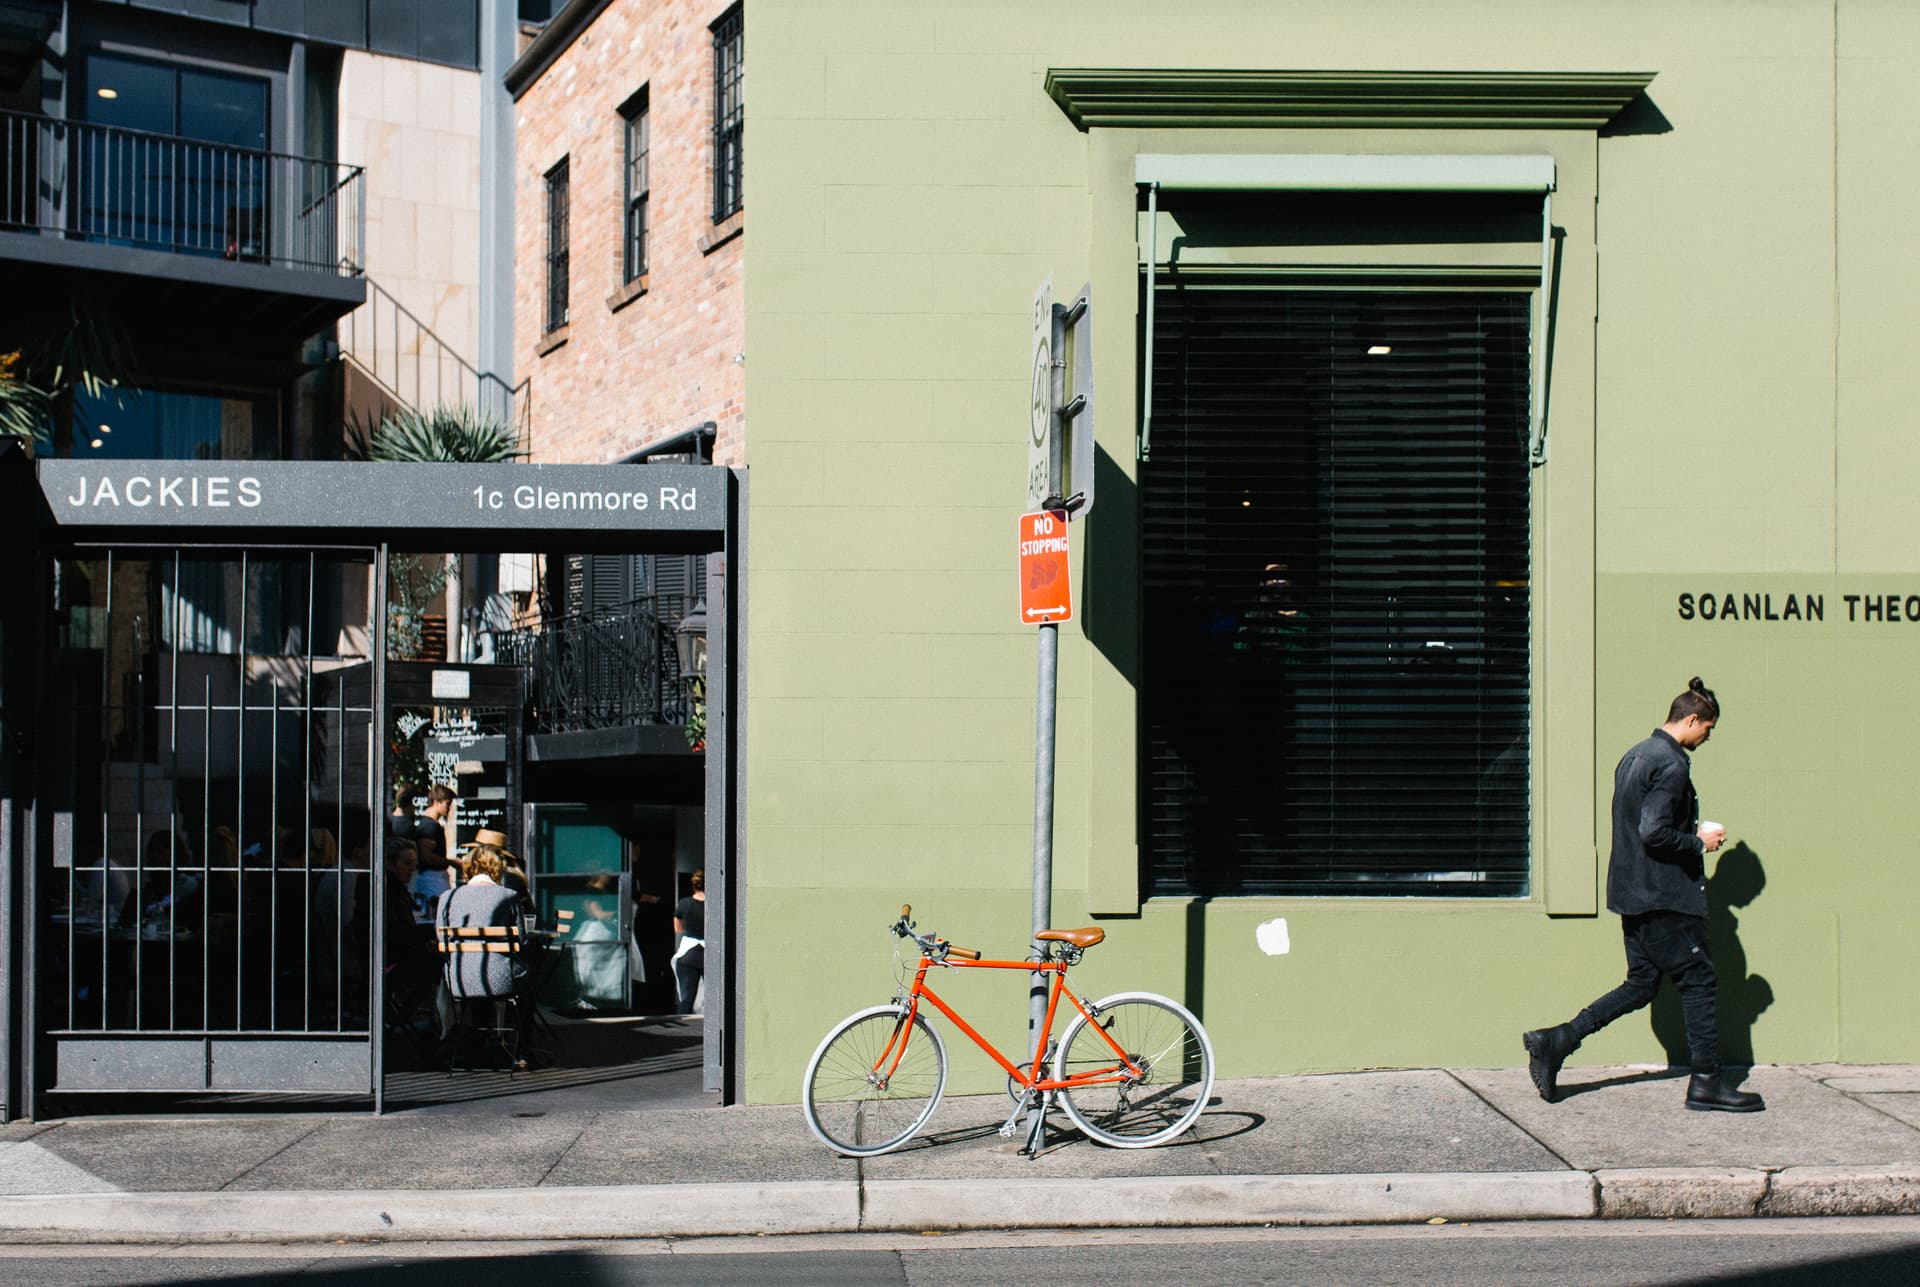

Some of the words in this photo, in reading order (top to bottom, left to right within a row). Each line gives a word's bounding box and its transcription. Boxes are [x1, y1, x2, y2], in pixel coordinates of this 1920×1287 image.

[68, 476, 262, 508] JACKIES
[1028, 456, 1049, 501] AREA
[473, 485, 503, 509] 1c
[513, 485, 649, 510] Glenmore
[660, 487, 697, 511] Rd
[1034, 516, 1053, 536] NO
[1021, 536, 1068, 556] STOPPING
[1843, 594, 1920, 622] THEO
